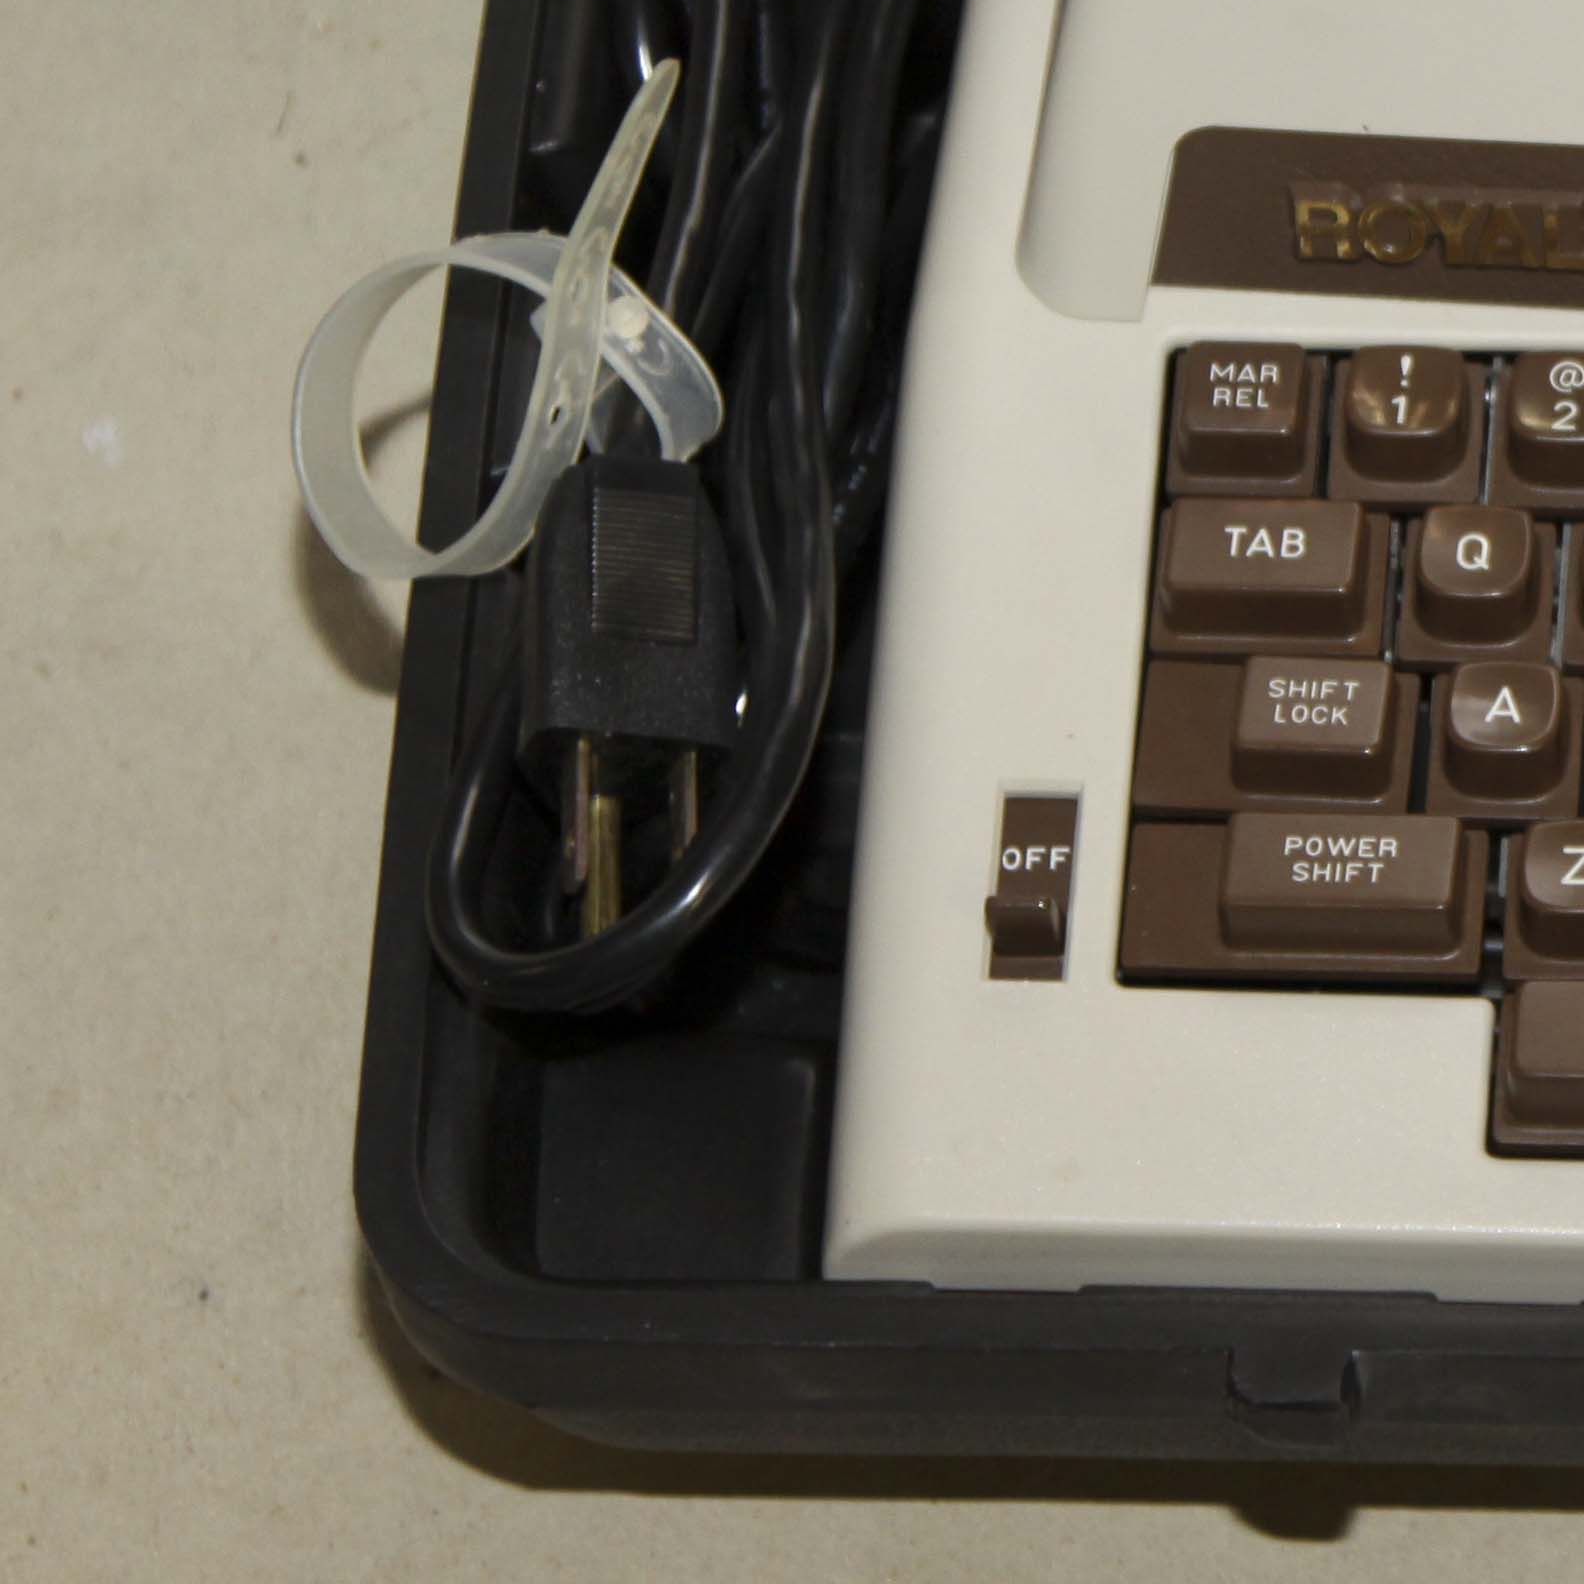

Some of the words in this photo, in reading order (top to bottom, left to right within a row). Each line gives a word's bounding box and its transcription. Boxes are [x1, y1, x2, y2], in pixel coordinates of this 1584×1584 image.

[1208, 362, 1280, 384] MAR
[1399, 354, 1414, 388] !
[1211, 386, 1270, 409] REL
[1391, 394, 1408, 425] 1
[1549, 399, 1579, 432] 2
[1223, 525, 1307, 560] TAB
[1455, 532, 1491, 571] Q
[1268, 677, 1360, 702] SHIFT
[1273, 702, 1349, 726] LOCK
[1483, 685, 1522, 724] A
[1001, 846, 1071, 871] OFF
[1283, 835, 1399, 859] POWER
[1291, 860, 1385, 884] SHIFT
